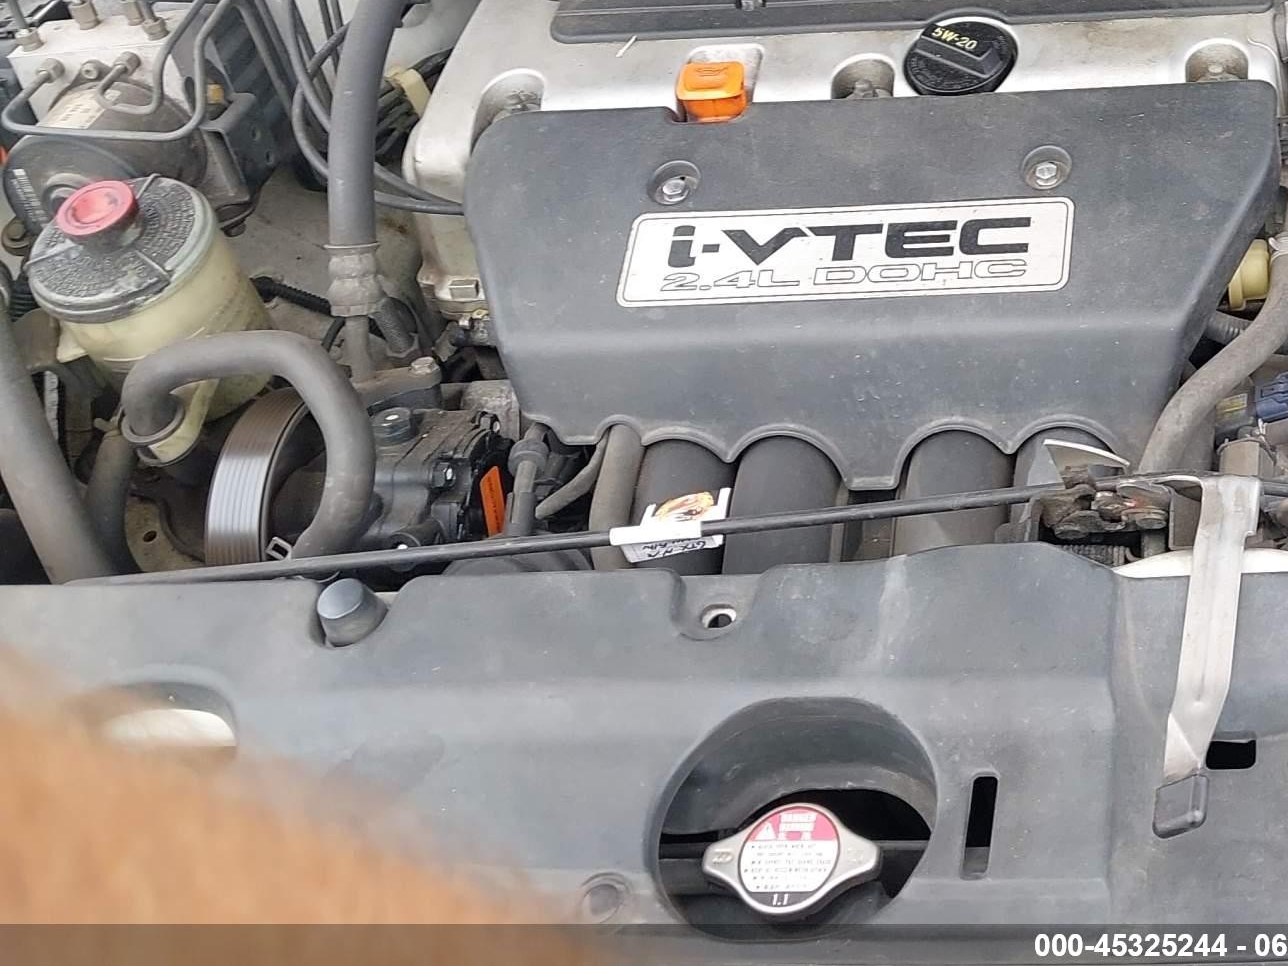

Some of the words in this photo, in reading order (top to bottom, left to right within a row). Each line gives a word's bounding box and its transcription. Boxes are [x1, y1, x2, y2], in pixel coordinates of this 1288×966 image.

[931, 27, 978, 50] 5W-20
[667, 216, 1032, 269] i-VTEC
[660, 269, 801, 292] 2.4L
[813, 259, 1027, 286] DOHC
[772, 893, 789, 906] 1.1
